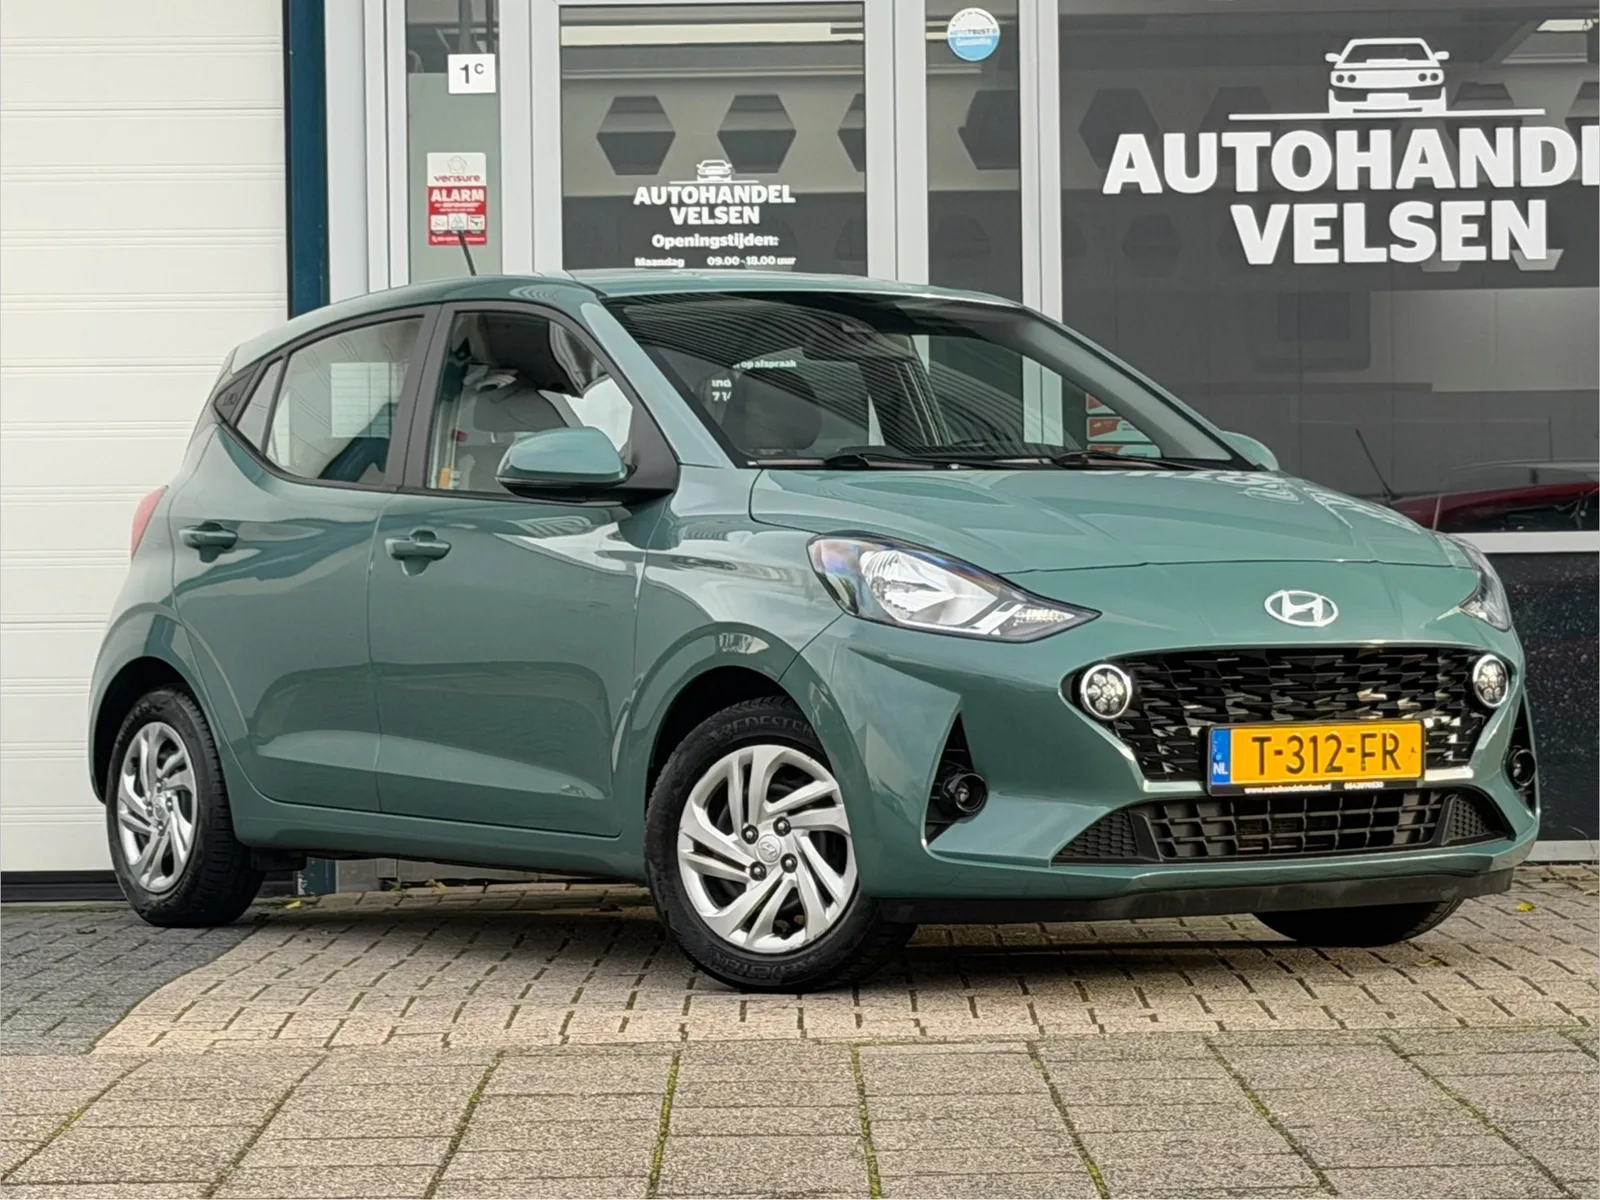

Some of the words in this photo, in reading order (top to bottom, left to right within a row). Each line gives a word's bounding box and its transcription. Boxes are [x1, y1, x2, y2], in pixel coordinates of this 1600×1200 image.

[431, 188, 484, 202] ALARM
[633, 185, 796, 205] AUTOHANDEL
[669, 206, 760, 225] VELSEN
[651, 233, 780, 250] Openingstijden:
[1230, 200, 1547, 265] VELSEN
[634, 257, 685, 268] Maandag
[776, 257, 796, 265] uur
[1251, 732, 1401, 776] T-312-FR
[1212, 763, 1229, 775] NL
